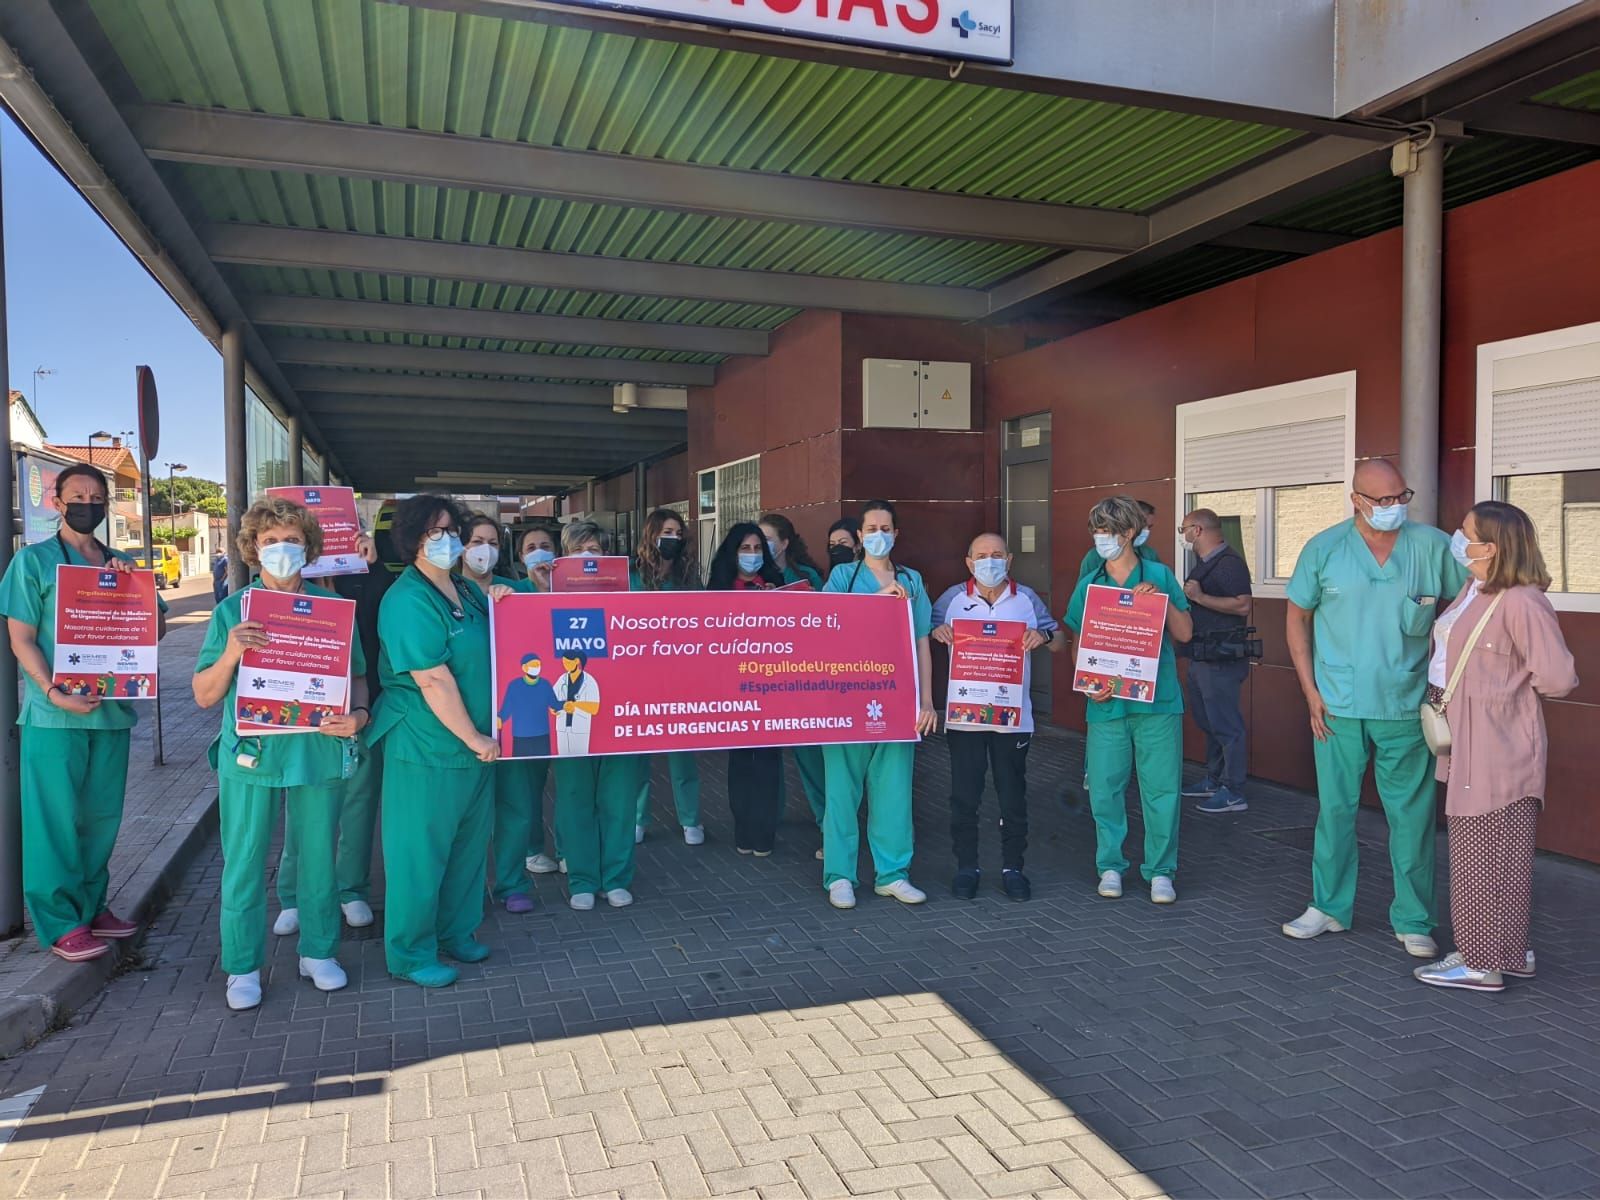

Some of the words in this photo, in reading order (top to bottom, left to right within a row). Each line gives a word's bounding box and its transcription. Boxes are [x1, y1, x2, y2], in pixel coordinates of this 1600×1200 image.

[978, 22, 1000, 34] Sacyl
[569, 617, 588, 630] 27
[610, 615, 699, 630] Nosotros
[704, 612, 796, 628] cuidamos
[800, 613, 822, 628] de
[826, 614, 842, 631] ti,
[555, 637, 606, 650] MAYO
[612, 642, 648, 661] por
[652, 639, 704, 656] favor
[708, 638, 794, 656] cuídanos
[738, 660, 896, 676] #OrgullodeUrgenciólogo
[739, 680, 897, 695] #EspecialidadUrgenciasYA
[614, 701, 641, 717] DÍA
[644, 700, 762, 716] INTERNACIONAL
[614, 725, 633, 738] DE
[637, 724, 664, 736] LAS
[667, 720, 749, 735] URGENCIAS
[751, 720, 761, 732] Y
[764, 716, 853, 731] EMERGENCIAS
